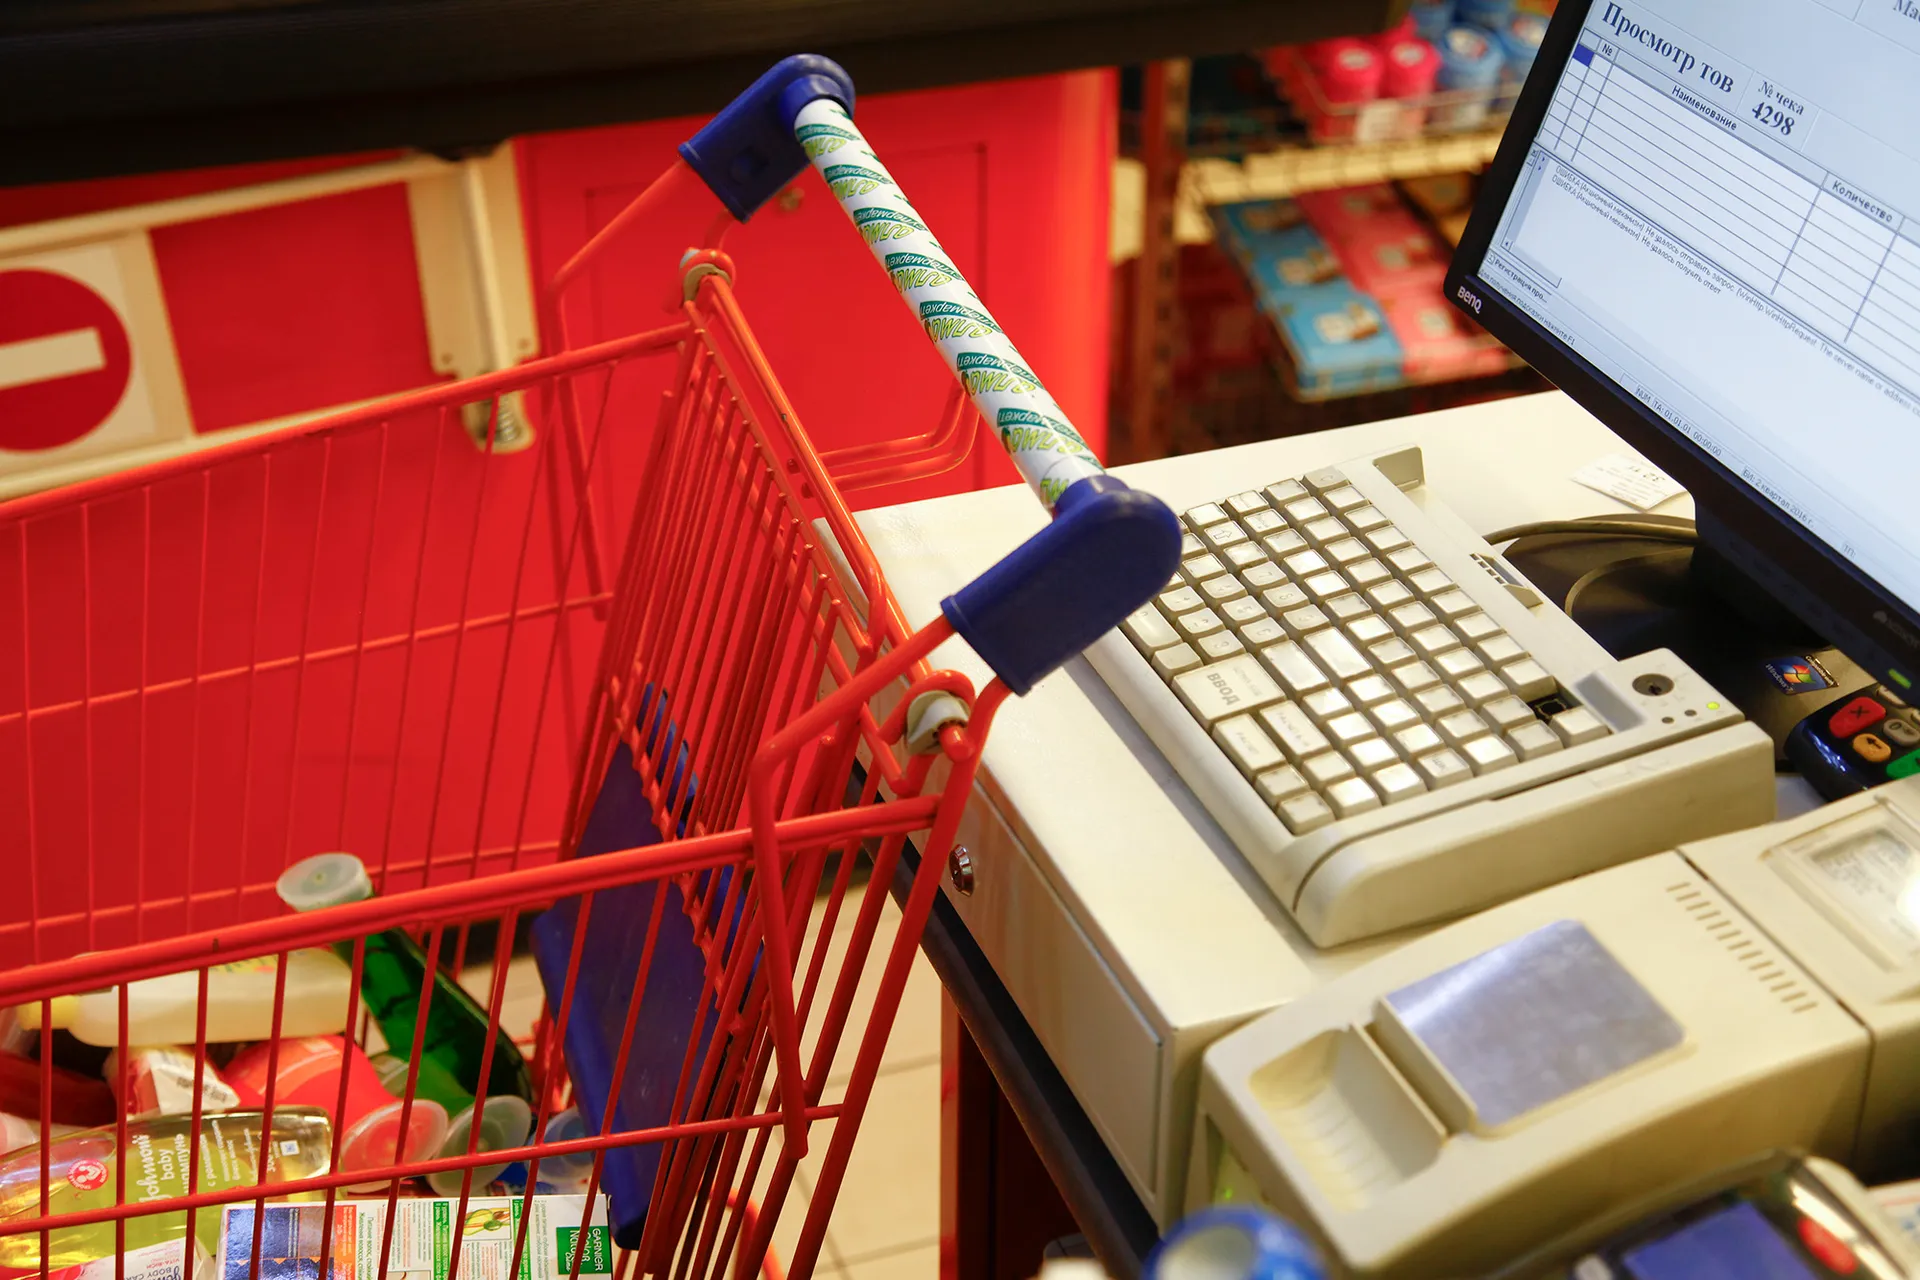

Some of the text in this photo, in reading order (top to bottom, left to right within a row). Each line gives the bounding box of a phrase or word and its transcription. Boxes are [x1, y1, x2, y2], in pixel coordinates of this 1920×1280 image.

[1601, 43, 1613, 57] №
[1602, 2, 1734, 93] Просмотр тов
[1672, 85, 1738, 131] Наименование
[1758, 80, 1805, 116] № чека
[1752, 101, 1795, 136] 4298
[1832, 179, 1893, 222] Количество
[1494, 259, 1532, 291] Регистрация
[1457, 286, 1482, 314] BenQ
[1207, 672, 1240, 706] ВВОД
[157, 1149, 175, 1180] baby
[147, 1267, 172, 1278] BODY
